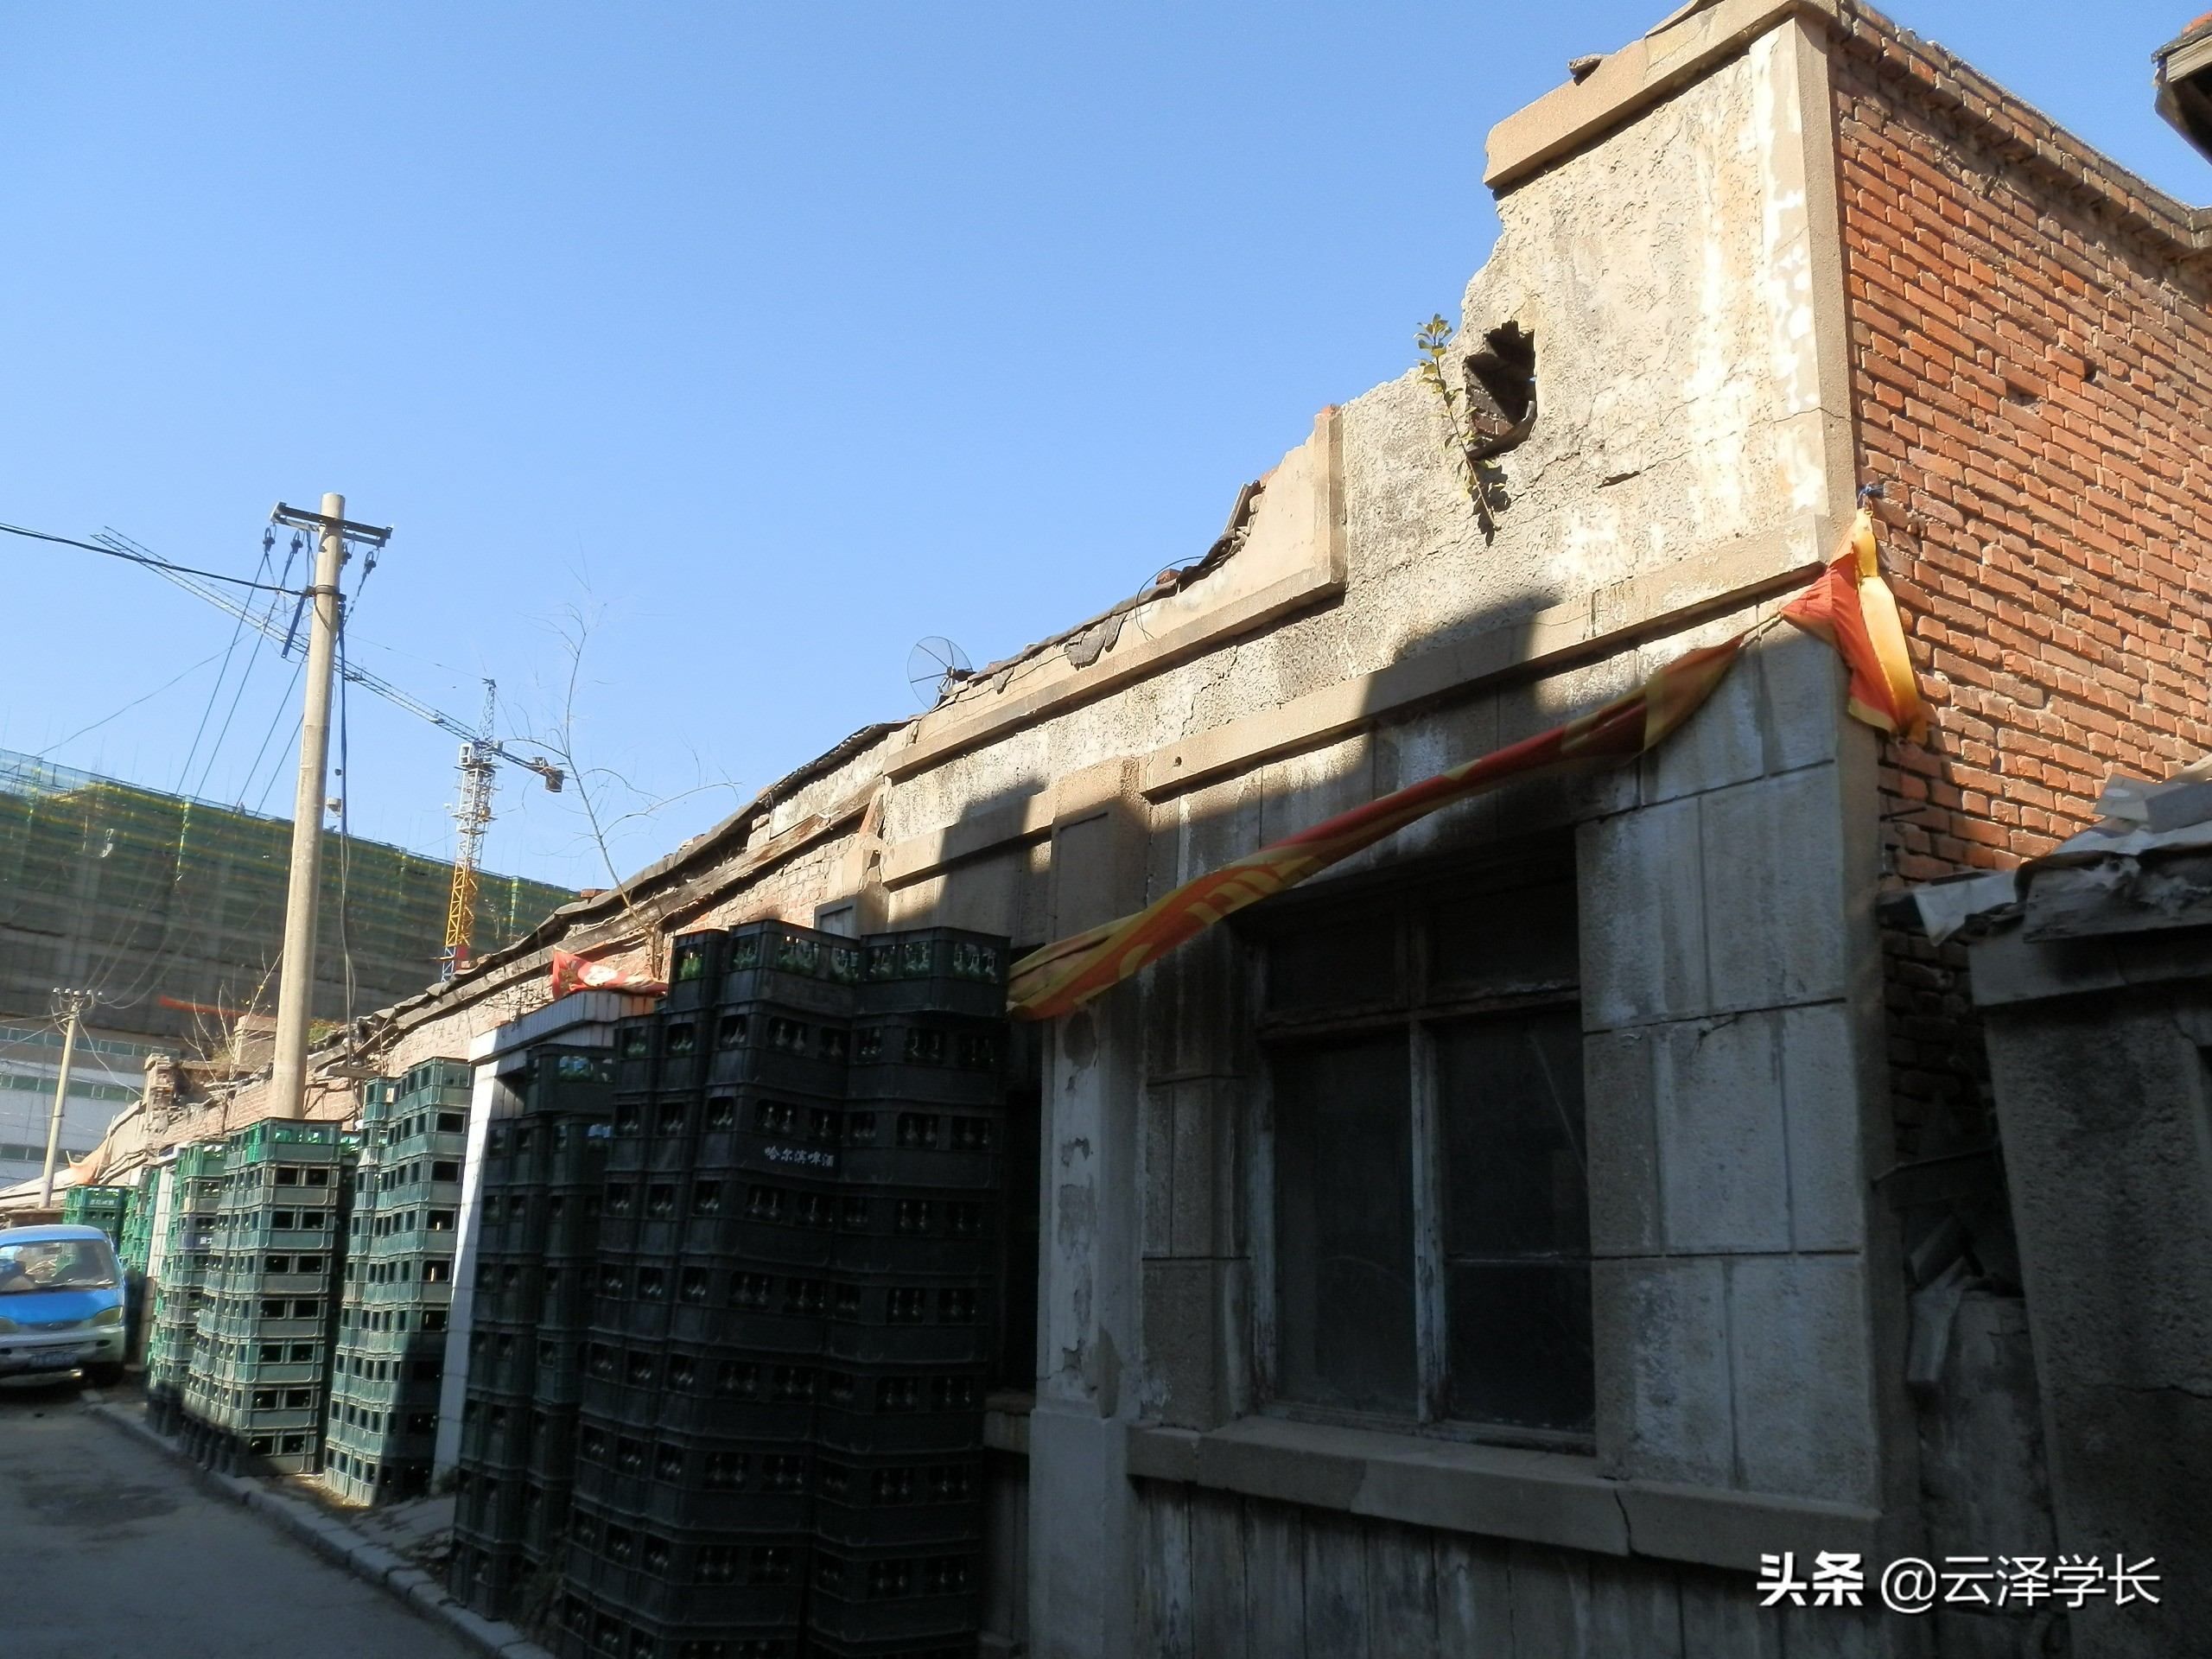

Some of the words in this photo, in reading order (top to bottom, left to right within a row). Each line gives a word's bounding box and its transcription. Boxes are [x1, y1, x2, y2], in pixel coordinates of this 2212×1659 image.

[765, 1146, 834, 1166] 哈尔滨啤酒
